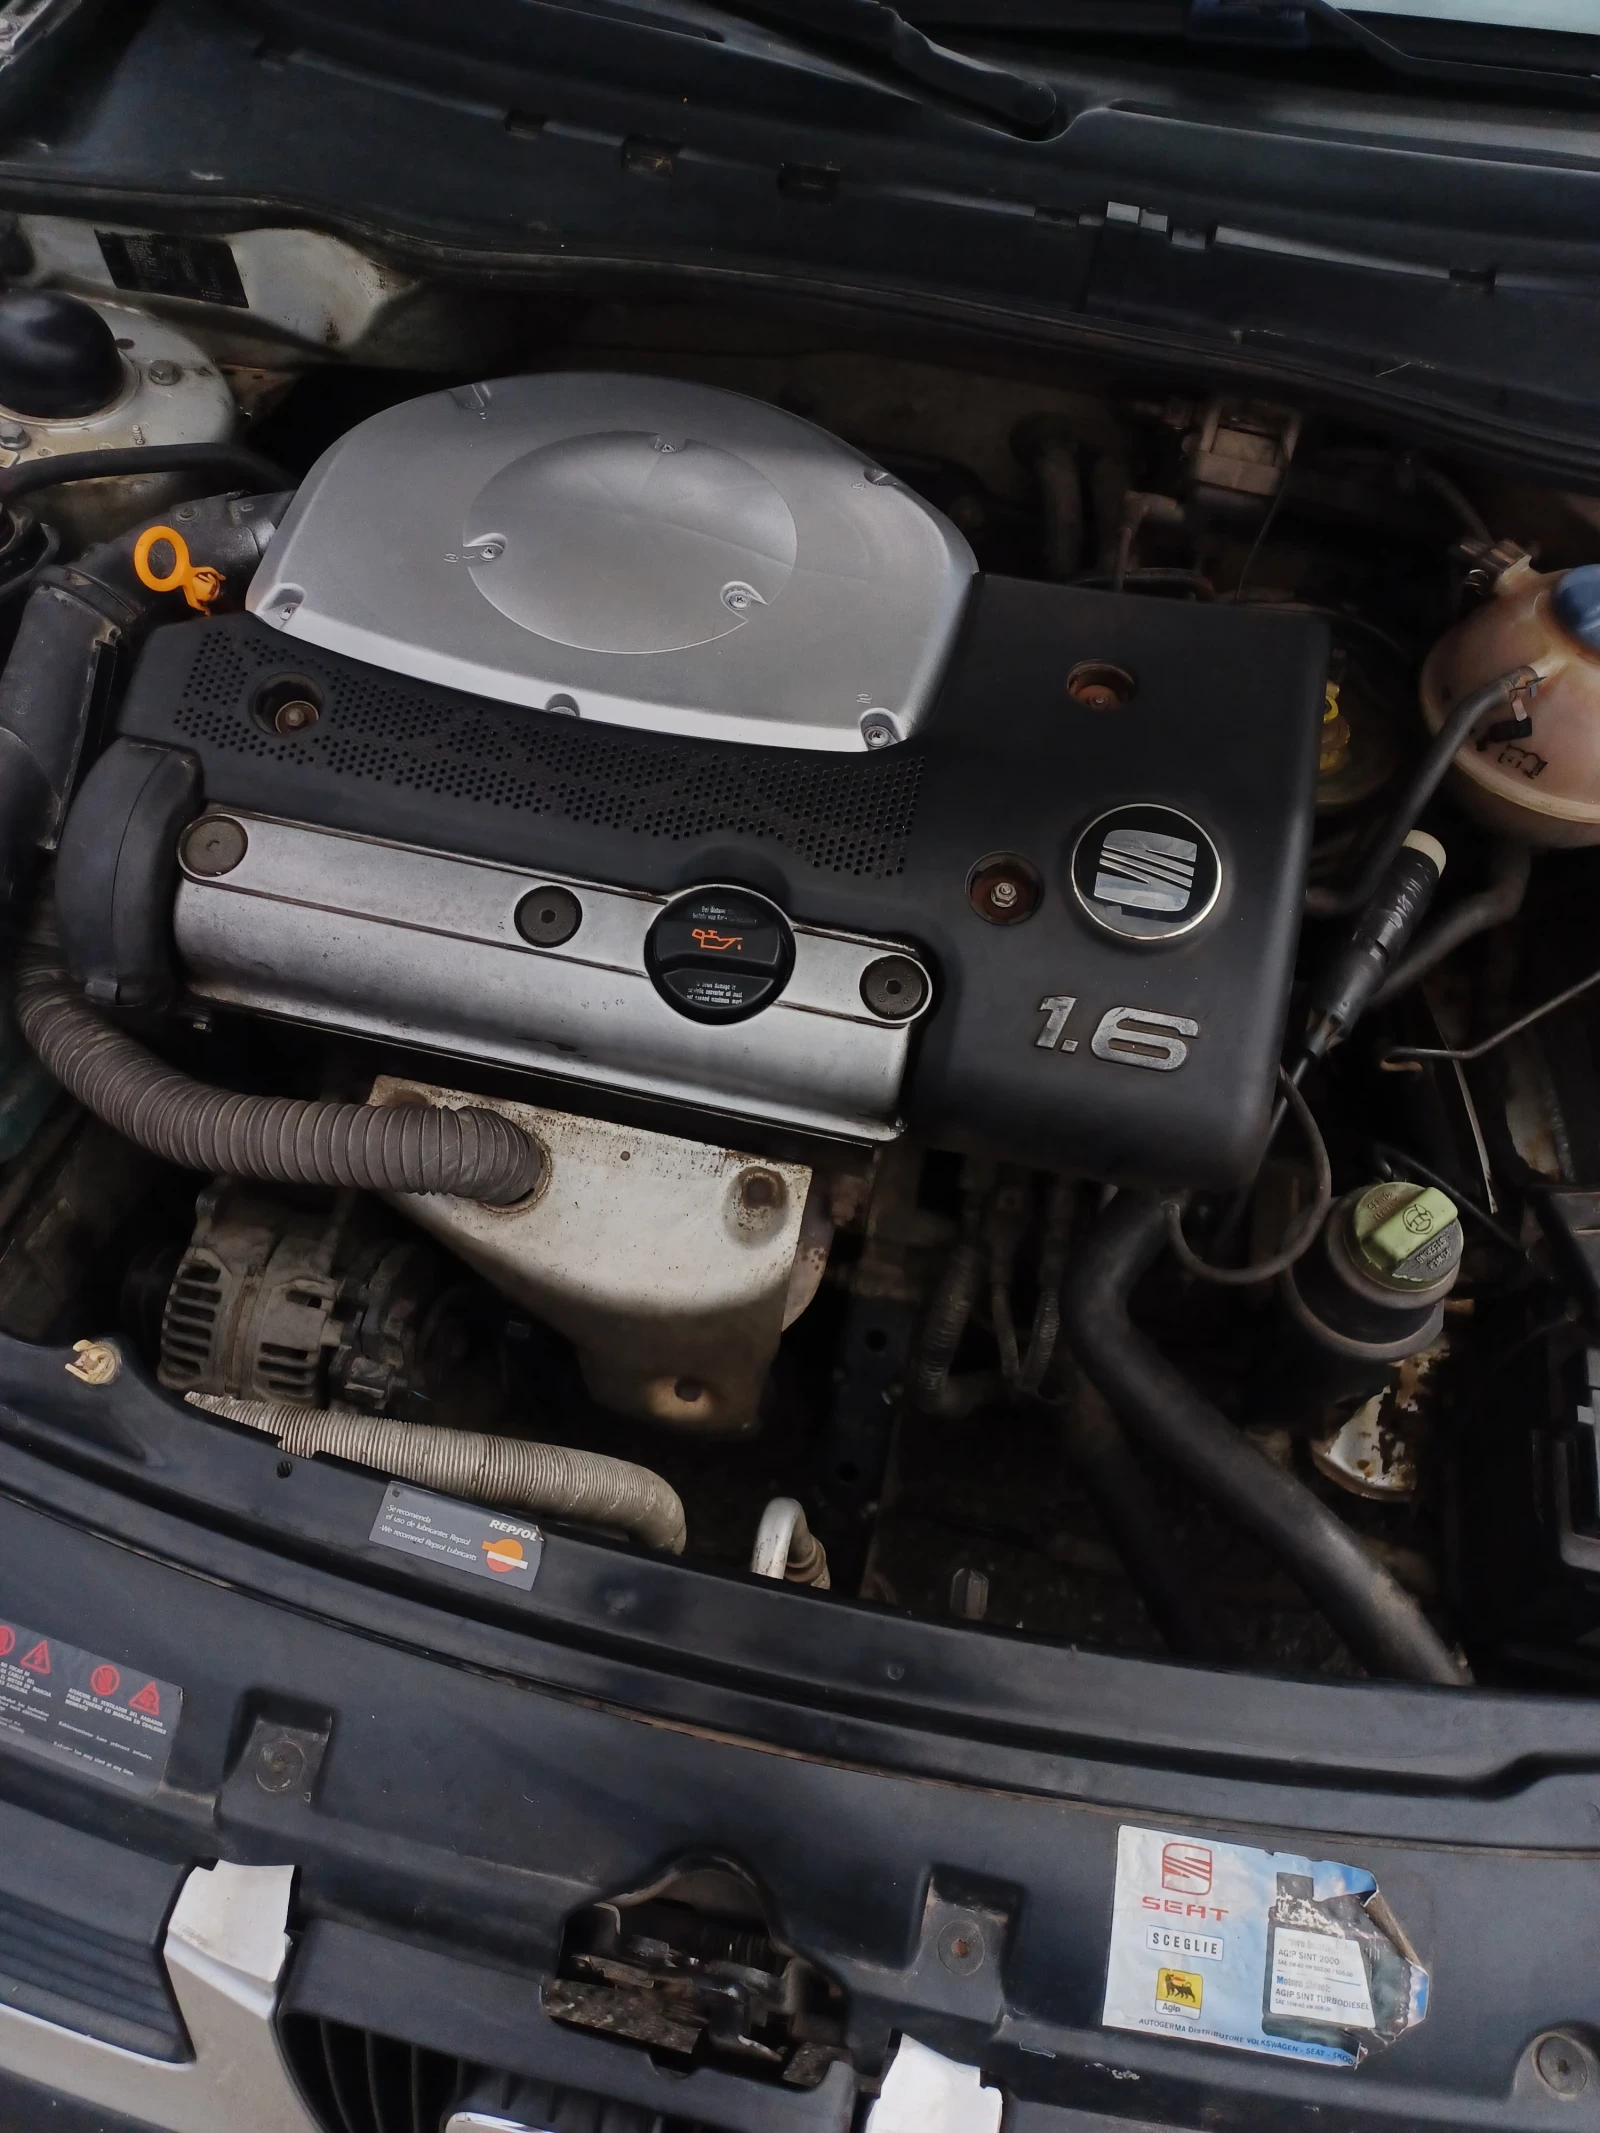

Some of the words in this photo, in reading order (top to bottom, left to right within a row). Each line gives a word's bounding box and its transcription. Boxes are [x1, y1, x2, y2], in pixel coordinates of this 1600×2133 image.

[1034, 995, 1200, 1072] 1.6
[396, 1508, 432, 1524] recomienda
[393, 1516, 404, 1524] uso
[406, 1519, 416, 1527] de
[416, 1521, 448, 1539] lubricantes
[449, 1533, 472, 1546] Repsol
[489, 1519, 537, 1542] REPSOL
[393, 1528, 424, 1544] recomend
[425, 1538, 446, 1552] Repsol
[447, 1545, 477, 1561] Lubricants
[1141, 1895, 1230, 1922] SEAT
[1152, 1932, 1218, 1955] SCEGLIE
[1278, 1949, 1296, 1958] AGIP
[1298, 1951, 1317, 1961] SINT
[1319, 1955, 1340, 1965] 2000
[1313, 1965, 1331, 1974] 502.00
[1335, 1969, 1354, 1978] 505.00
[1162, 2002, 1181, 2013] Agip
[1275, 1988, 1295, 1998] AGIP
[1296, 1991, 1315, 2001] SINT
[1316, 1994, 1370, 2011] TURBODIESEL
[1138, 2018, 1186, 2032] AUTOGERMA
[1247, 2038, 1298, 2052] VOLKSWAGEN
[1306, 2047, 1325, 2057] SEAT
